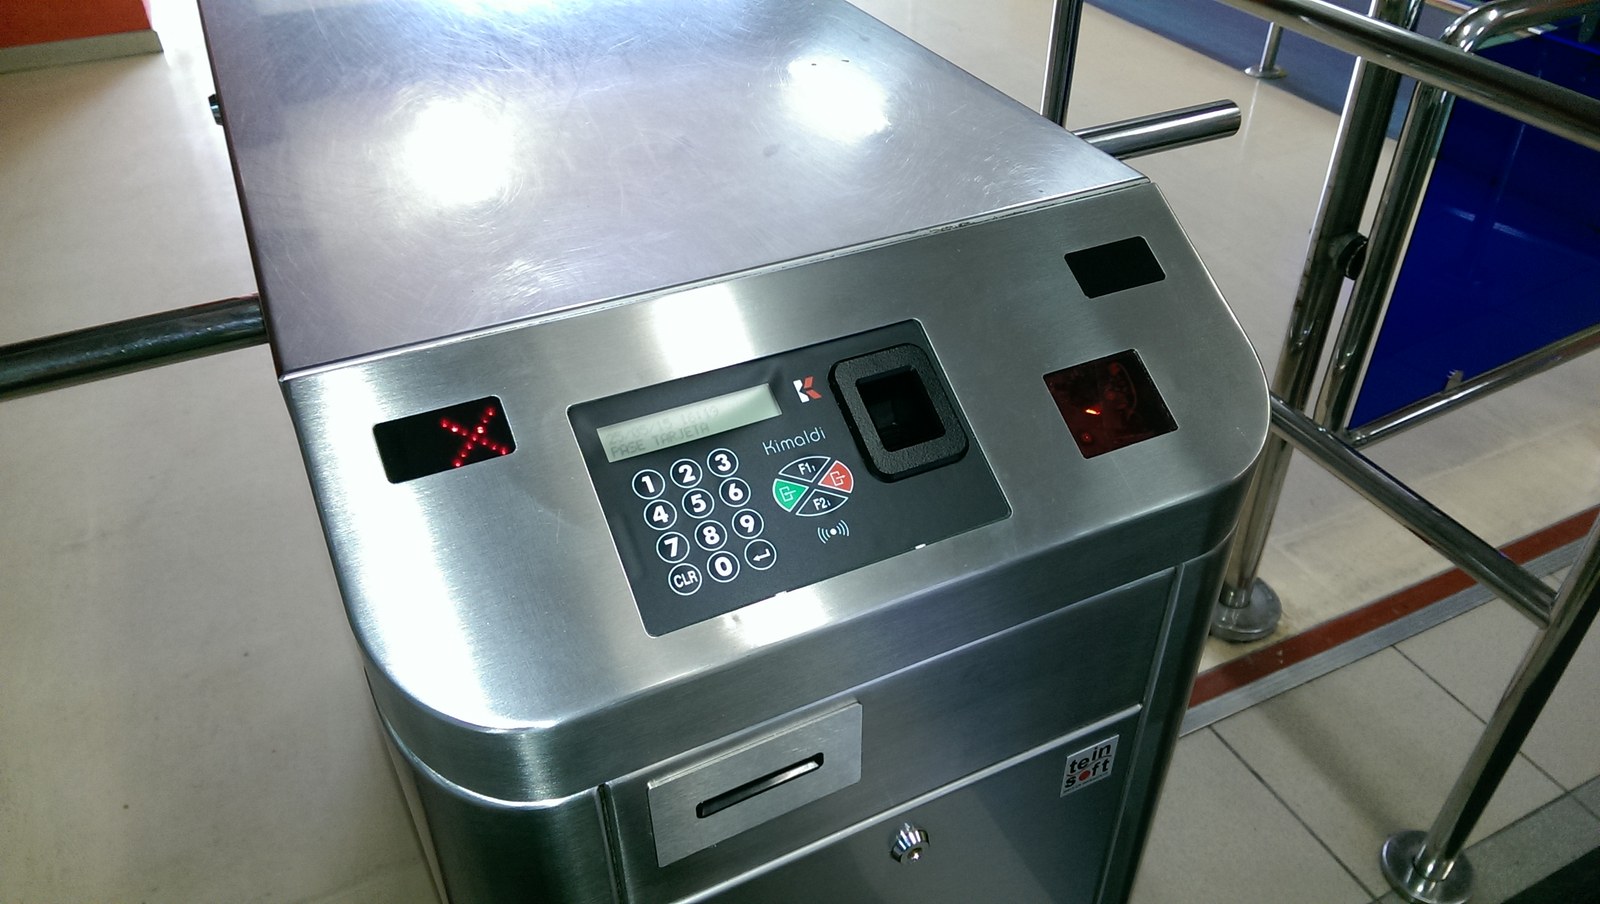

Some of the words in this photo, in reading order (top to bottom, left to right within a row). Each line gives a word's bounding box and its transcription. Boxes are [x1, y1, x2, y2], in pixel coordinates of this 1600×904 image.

[608, 438, 647, 458] PASE
[650, 420, 711, 447] TARJETA
[762, 426, 826, 456] Kimaldi
[641, 475, 655, 493] 1
[678, 464, 696, 483] 2
[714, 453, 732, 472] 3
[652, 505, 669, 523] 4
[690, 493, 707, 513] 5
[728, 482, 743, 501] 6
[663, 536, 679, 558] 7
[702, 525, 720, 545] 8
[739, 514, 755, 533] 9
[673, 570, 699, 588] CLR
[714, 556, 733, 577] 0
